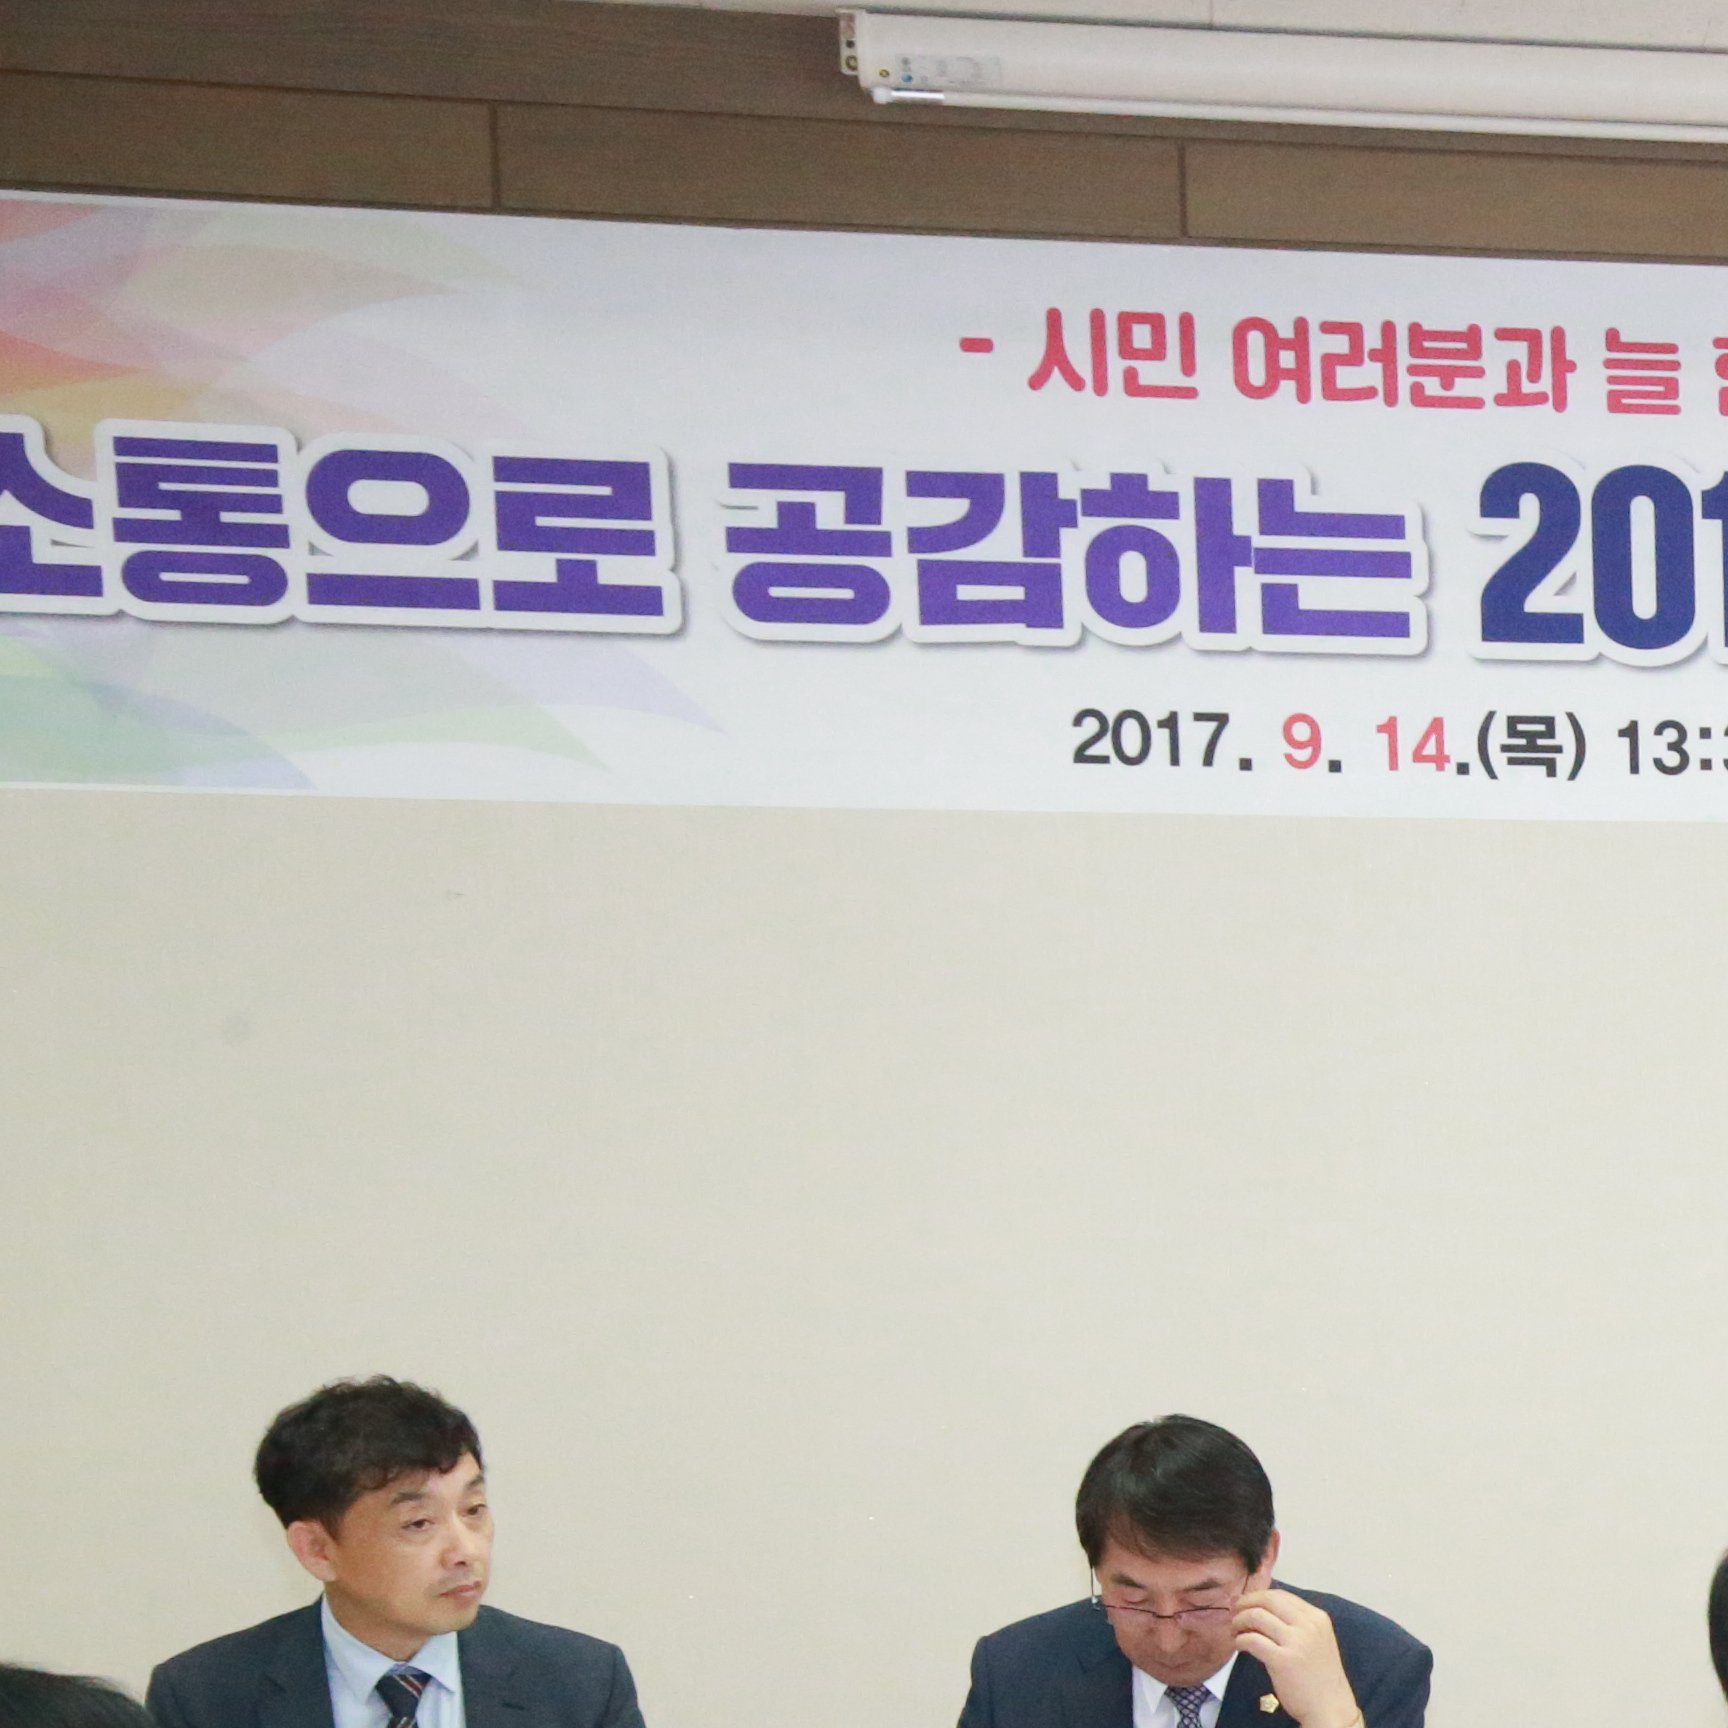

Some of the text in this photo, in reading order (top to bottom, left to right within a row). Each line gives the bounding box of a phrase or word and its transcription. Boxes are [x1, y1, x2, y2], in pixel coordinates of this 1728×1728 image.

[1027, 307, 1200, 401] 시민
[1231, 316, 1578, 414] 여러분과
[1603, 327, 1682, 416] 늘
[726, 462, 1413, 639] 공감하는
[1071, 707, 1253, 772] 2017.
[1282, 712, 1343, 774] 9.
